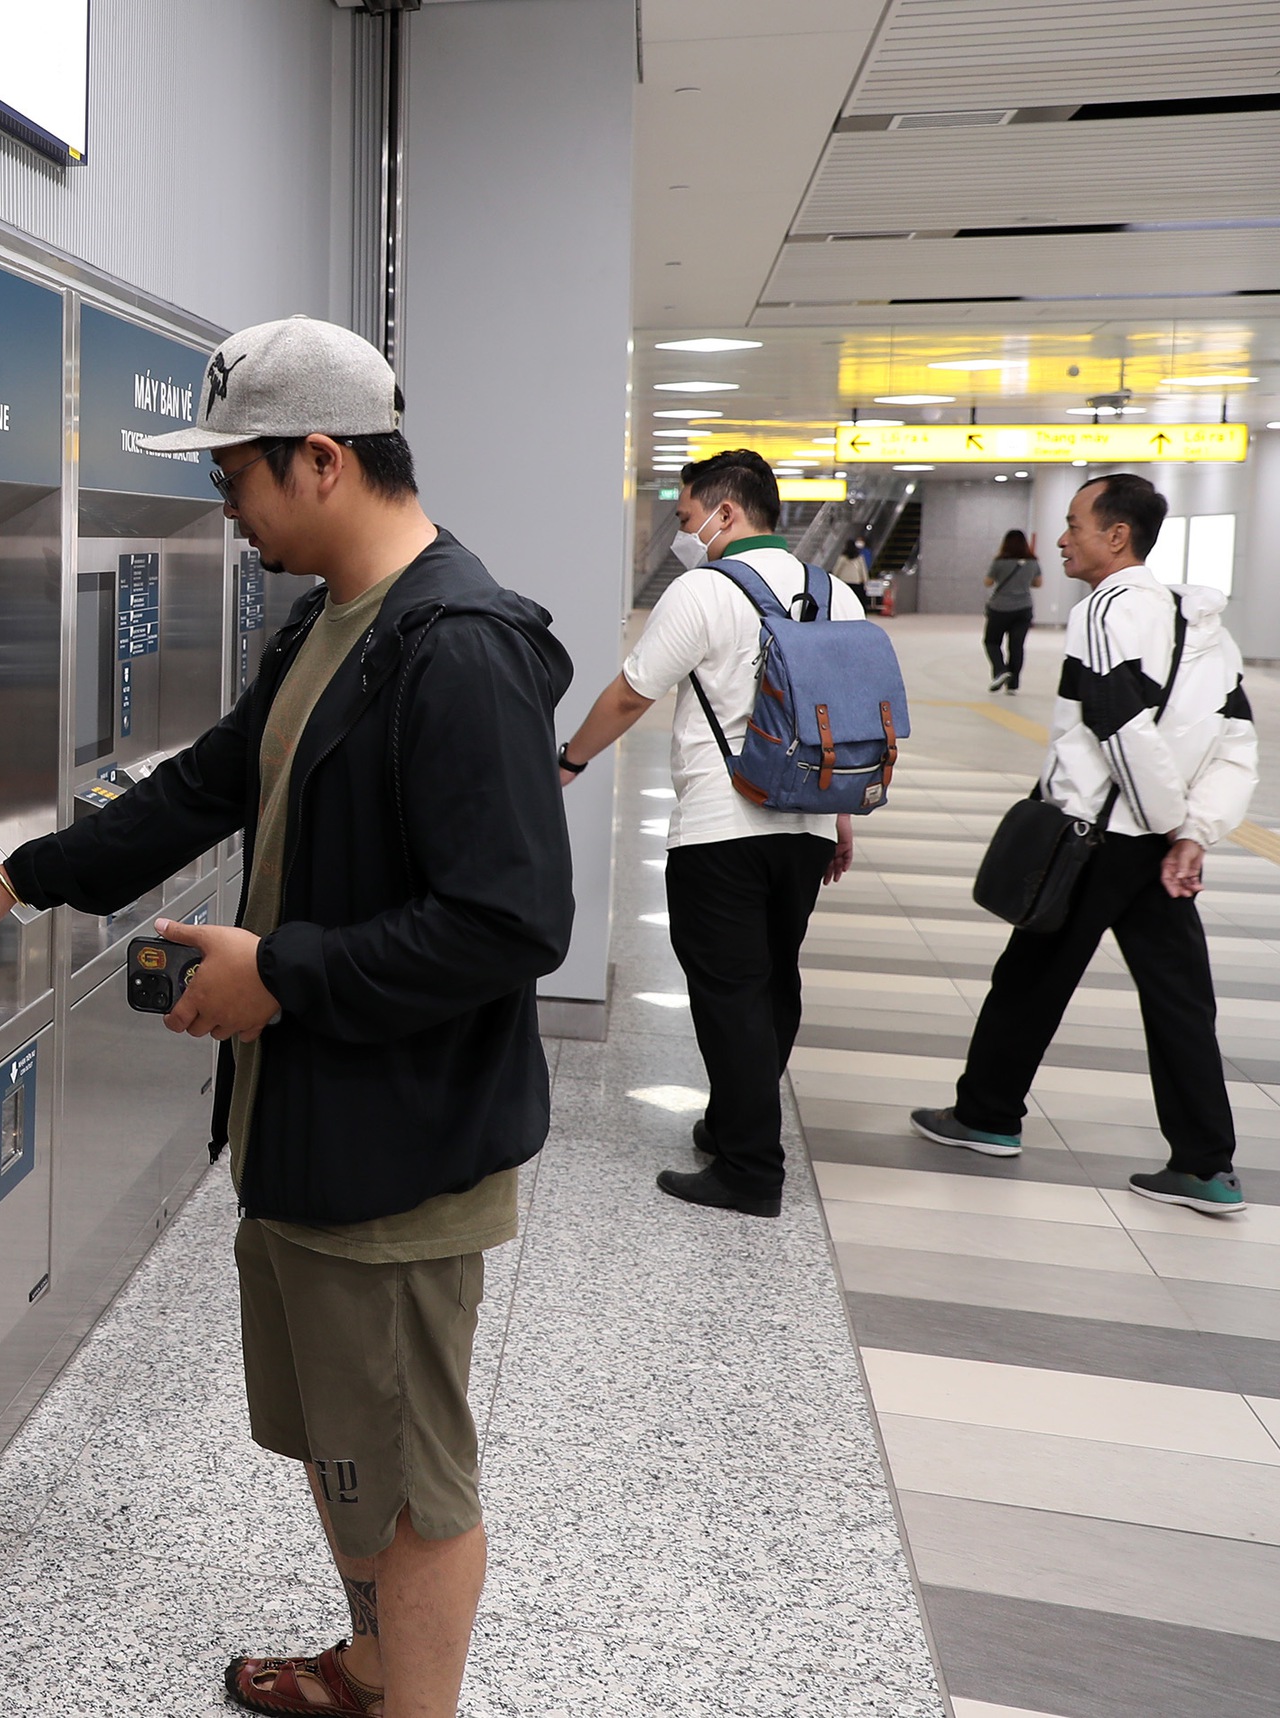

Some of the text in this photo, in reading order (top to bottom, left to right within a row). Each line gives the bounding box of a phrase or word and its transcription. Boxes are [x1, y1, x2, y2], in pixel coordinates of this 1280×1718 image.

[134, 369, 192, 422] MÁY BÁN VÉ
[1036, 431, 1075, 444] Thang
